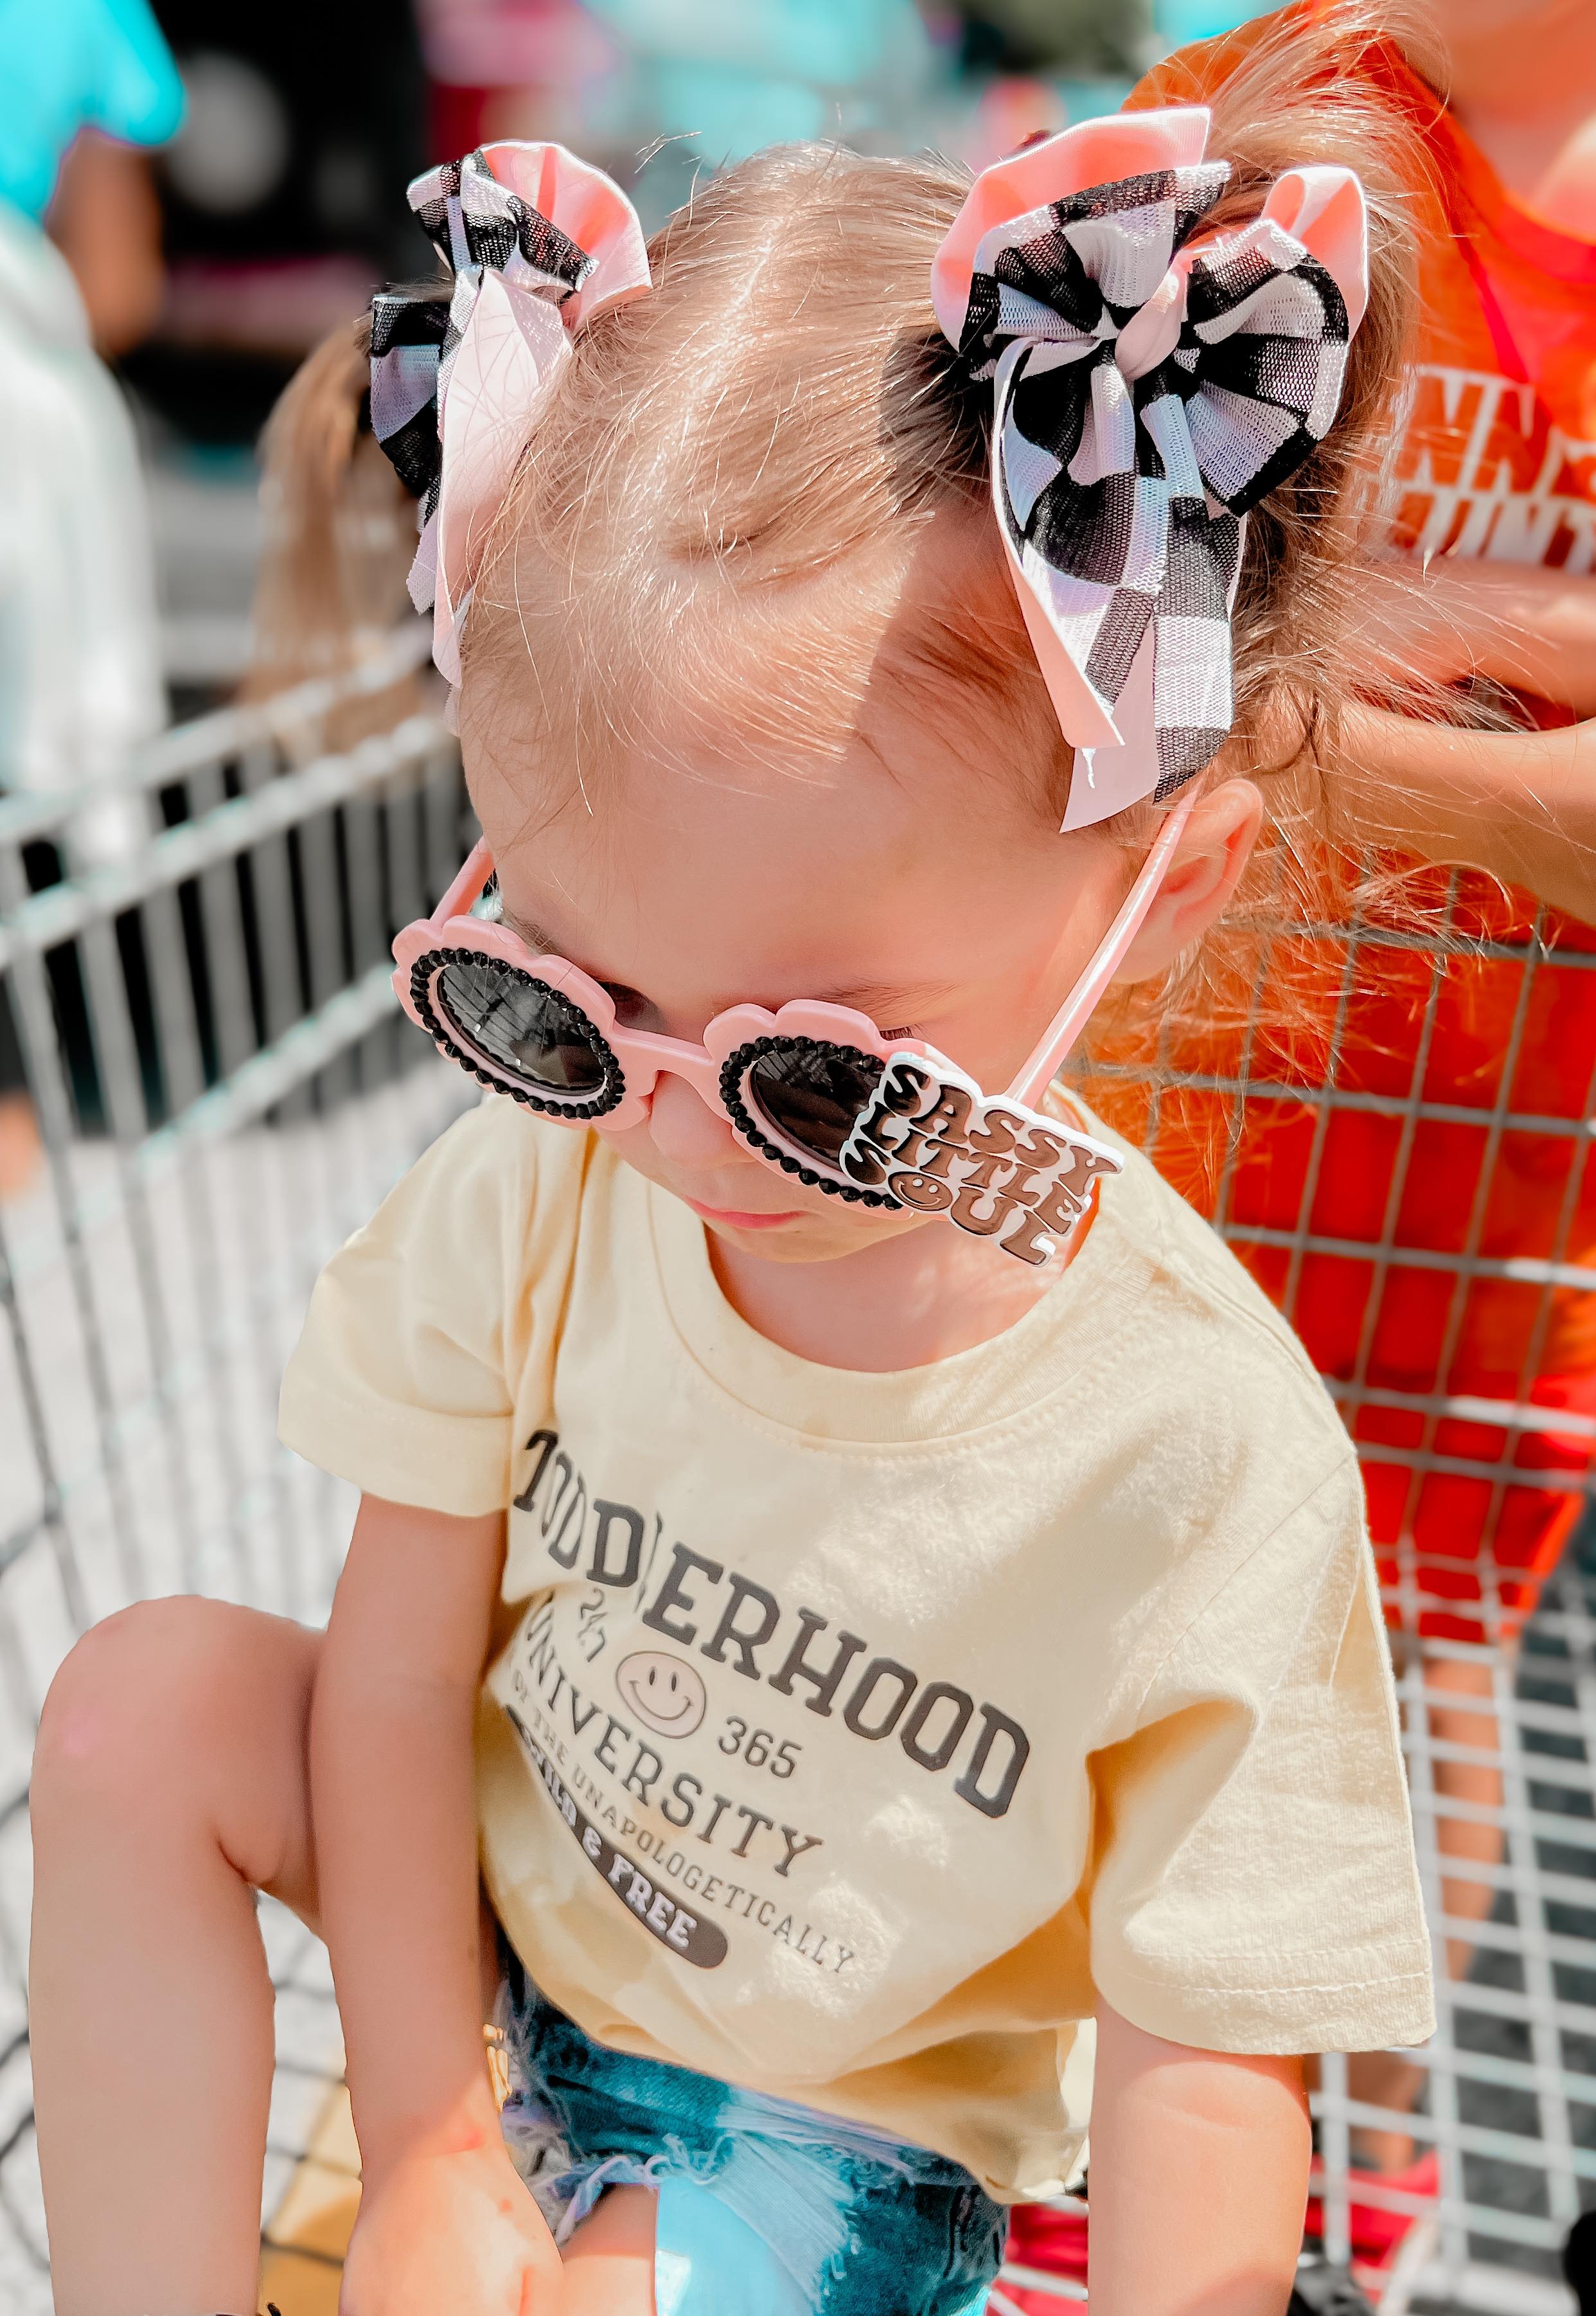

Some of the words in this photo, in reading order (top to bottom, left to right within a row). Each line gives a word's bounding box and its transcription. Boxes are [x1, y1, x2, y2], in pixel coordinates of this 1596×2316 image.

[860, 1100, 1083, 1234] LITTLE
[883, 1064, 1118, 1197] SASSY
[513, 1429, 1031, 1819] TODDERHOOD
[526, 1589, 824, 1878] UNIVERSITY
[718, 1715, 802, 1779] 365
[572, 1763, 855, 1973] UNAPOLOGETICALLY
[581, 1825, 603, 1857] &
[607, 1853, 698, 1948] FREE
